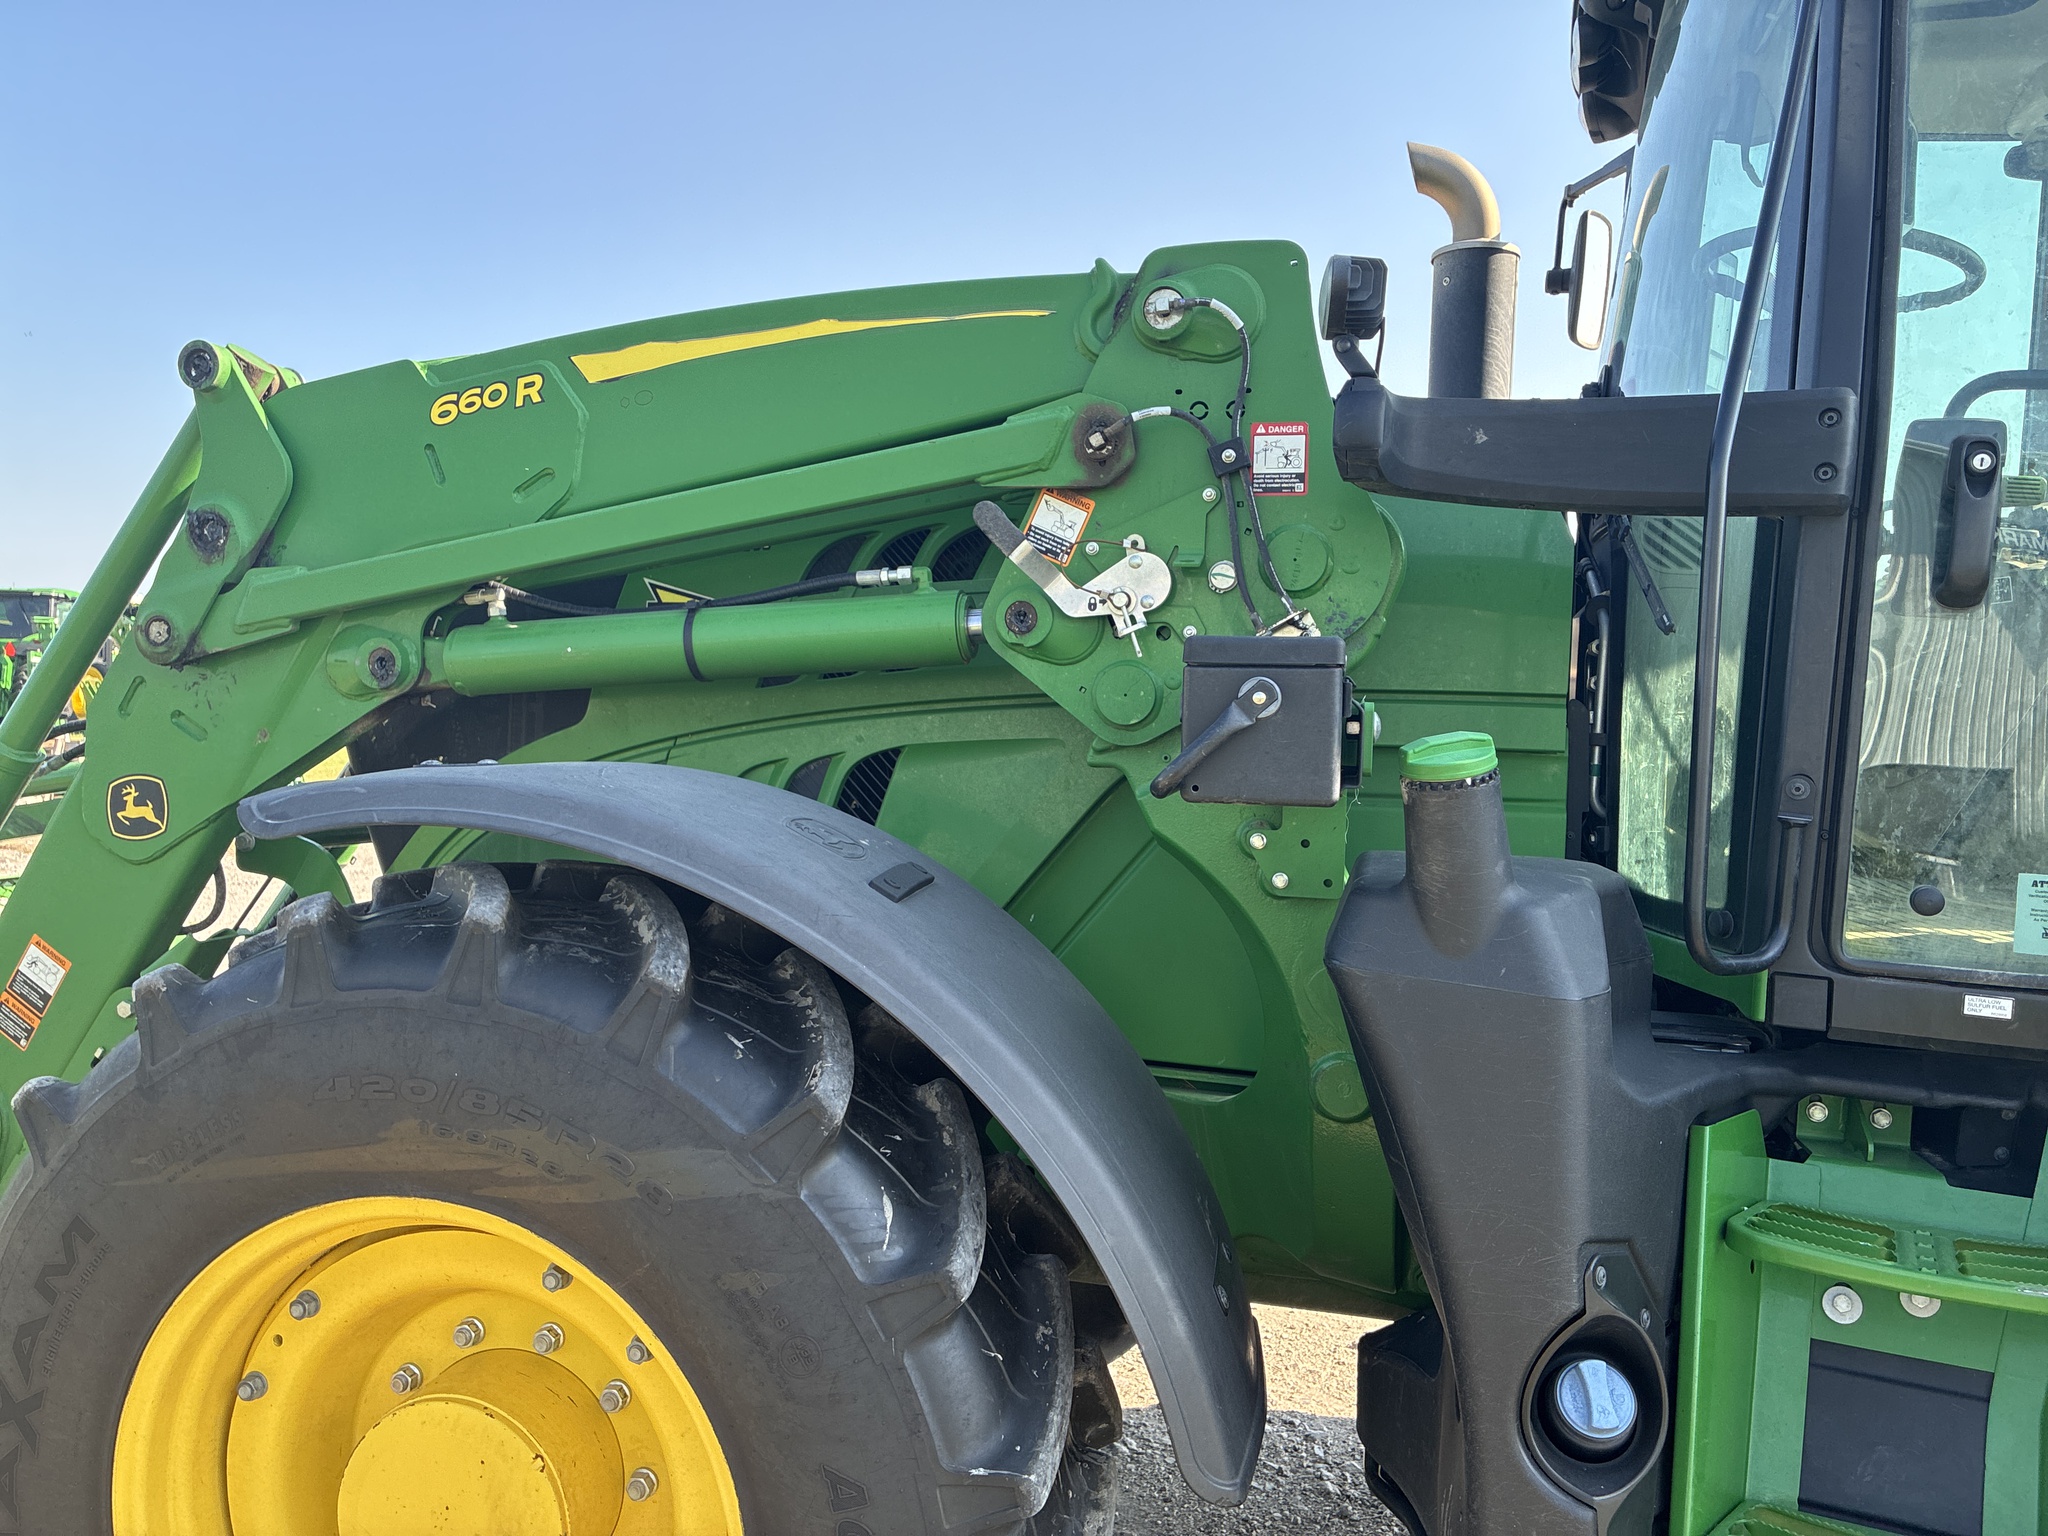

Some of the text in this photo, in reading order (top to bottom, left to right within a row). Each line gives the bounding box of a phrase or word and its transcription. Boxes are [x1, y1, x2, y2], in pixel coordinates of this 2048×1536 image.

[430, 371, 546, 427] 660 R
[1268, 425, 1304, 434] DANGER
[1055, 490, 1091, 510] WARNING
[42, 944, 67, 967] WARNING
[11, 1002, 36, 1025] WARNING
